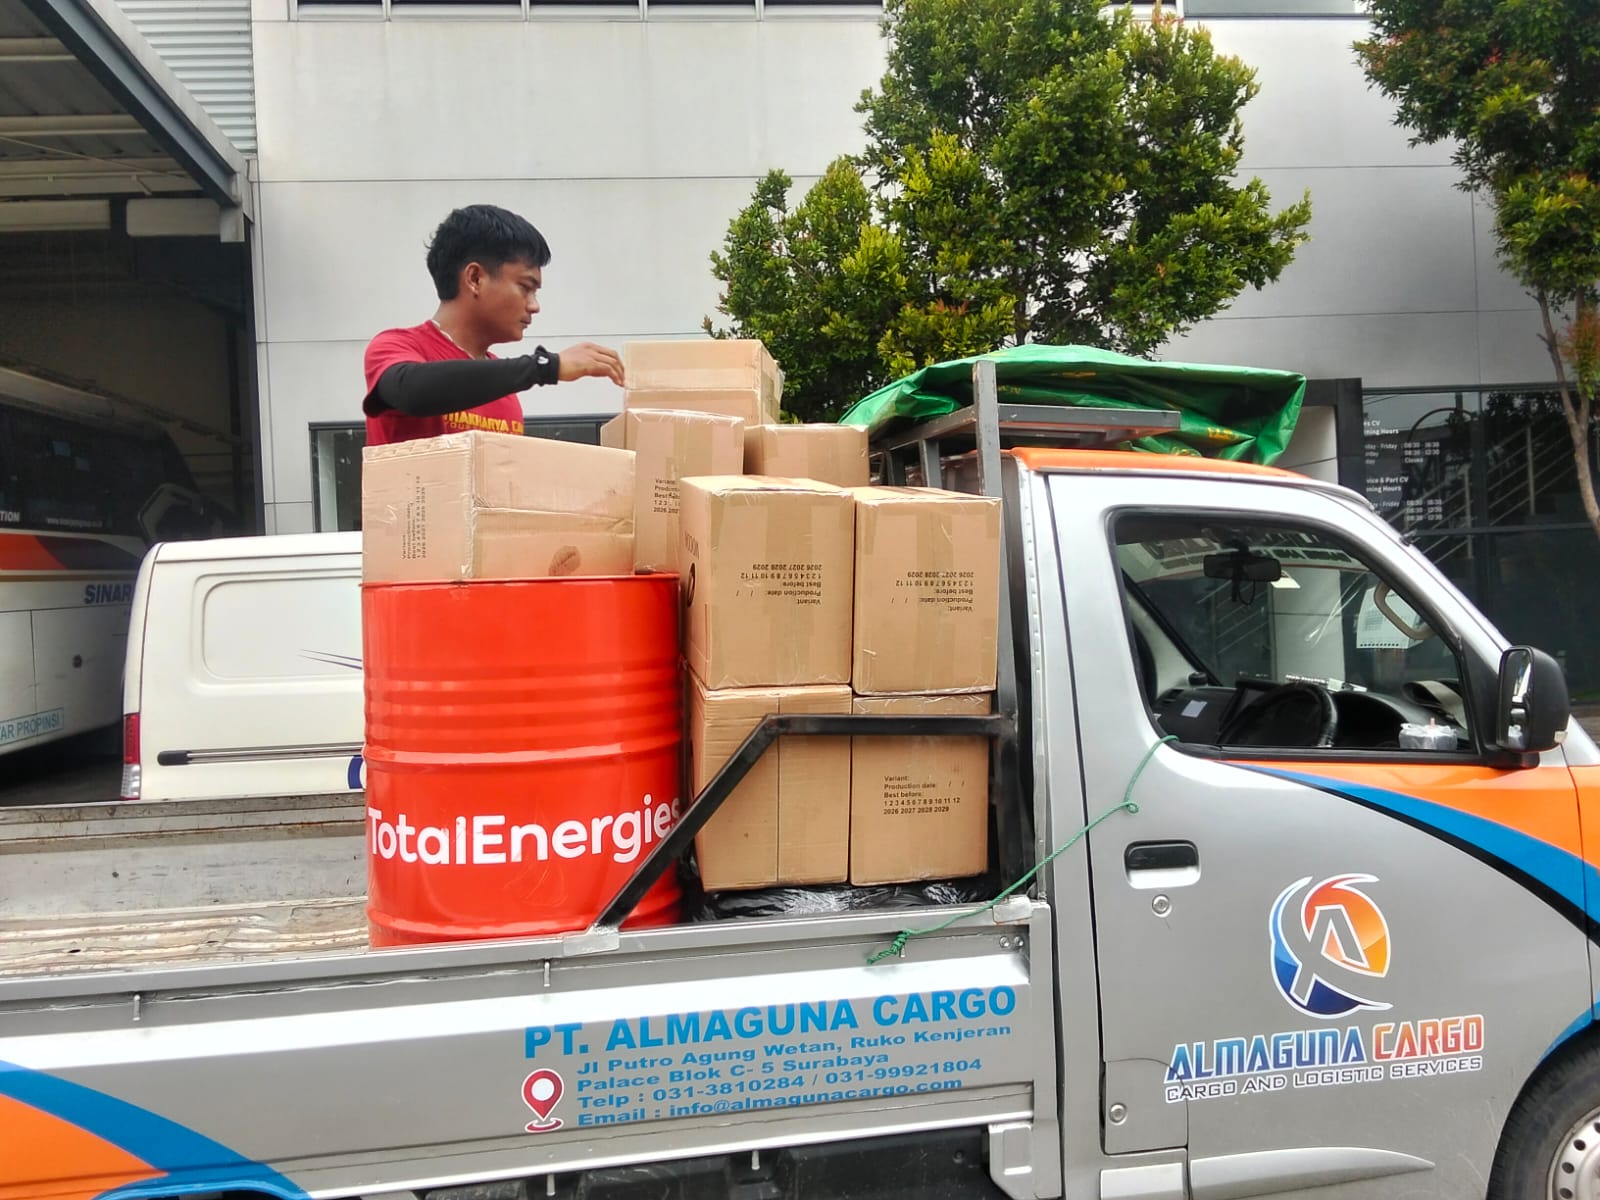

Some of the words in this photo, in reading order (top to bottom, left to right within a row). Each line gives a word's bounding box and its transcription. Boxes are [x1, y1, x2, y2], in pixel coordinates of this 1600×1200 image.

[17, 712, 59, 736] PROPINSI
[524, 1022, 589, 1059] PT.
[605, 999, 858, 1051] ALMAGUNA
[872, 984, 1016, 1026] CARGO
[608, 1055, 673, 1072] Putro
[681, 1049, 756, 1066] Agung
[763, 1041, 843, 1056] Wetan,
[850, 1034, 906, 1049] Ruko
[914, 1025, 1012, 1042] Kenjeran
[1165, 1026, 1367, 1083] ALMAGUNA
[1373, 1014, 1483, 1061] CARGO
[577, 1075, 660, 1092] Palace
[669, 1067, 721, 1083] Blok
[761, 1060, 774, 1074] 5
[783, 1053, 889, 1072] Surabaya
[577, 1095, 629, 1109] Telp
[653, 1075, 805, 1102] 031-3810284
[825, 1058, 983, 1086] 031-99921804
[1166, 1081, 1236, 1102] CARGO
[1243, 1076, 1287, 1092] AND
[1295, 1067, 1382, 1087] LOGISTIC
[1391, 1057, 1481, 1078] SERVICES
[578, 1108, 646, 1126] Email
[669, 1079, 963, 1117] info@almagunacargo.com
